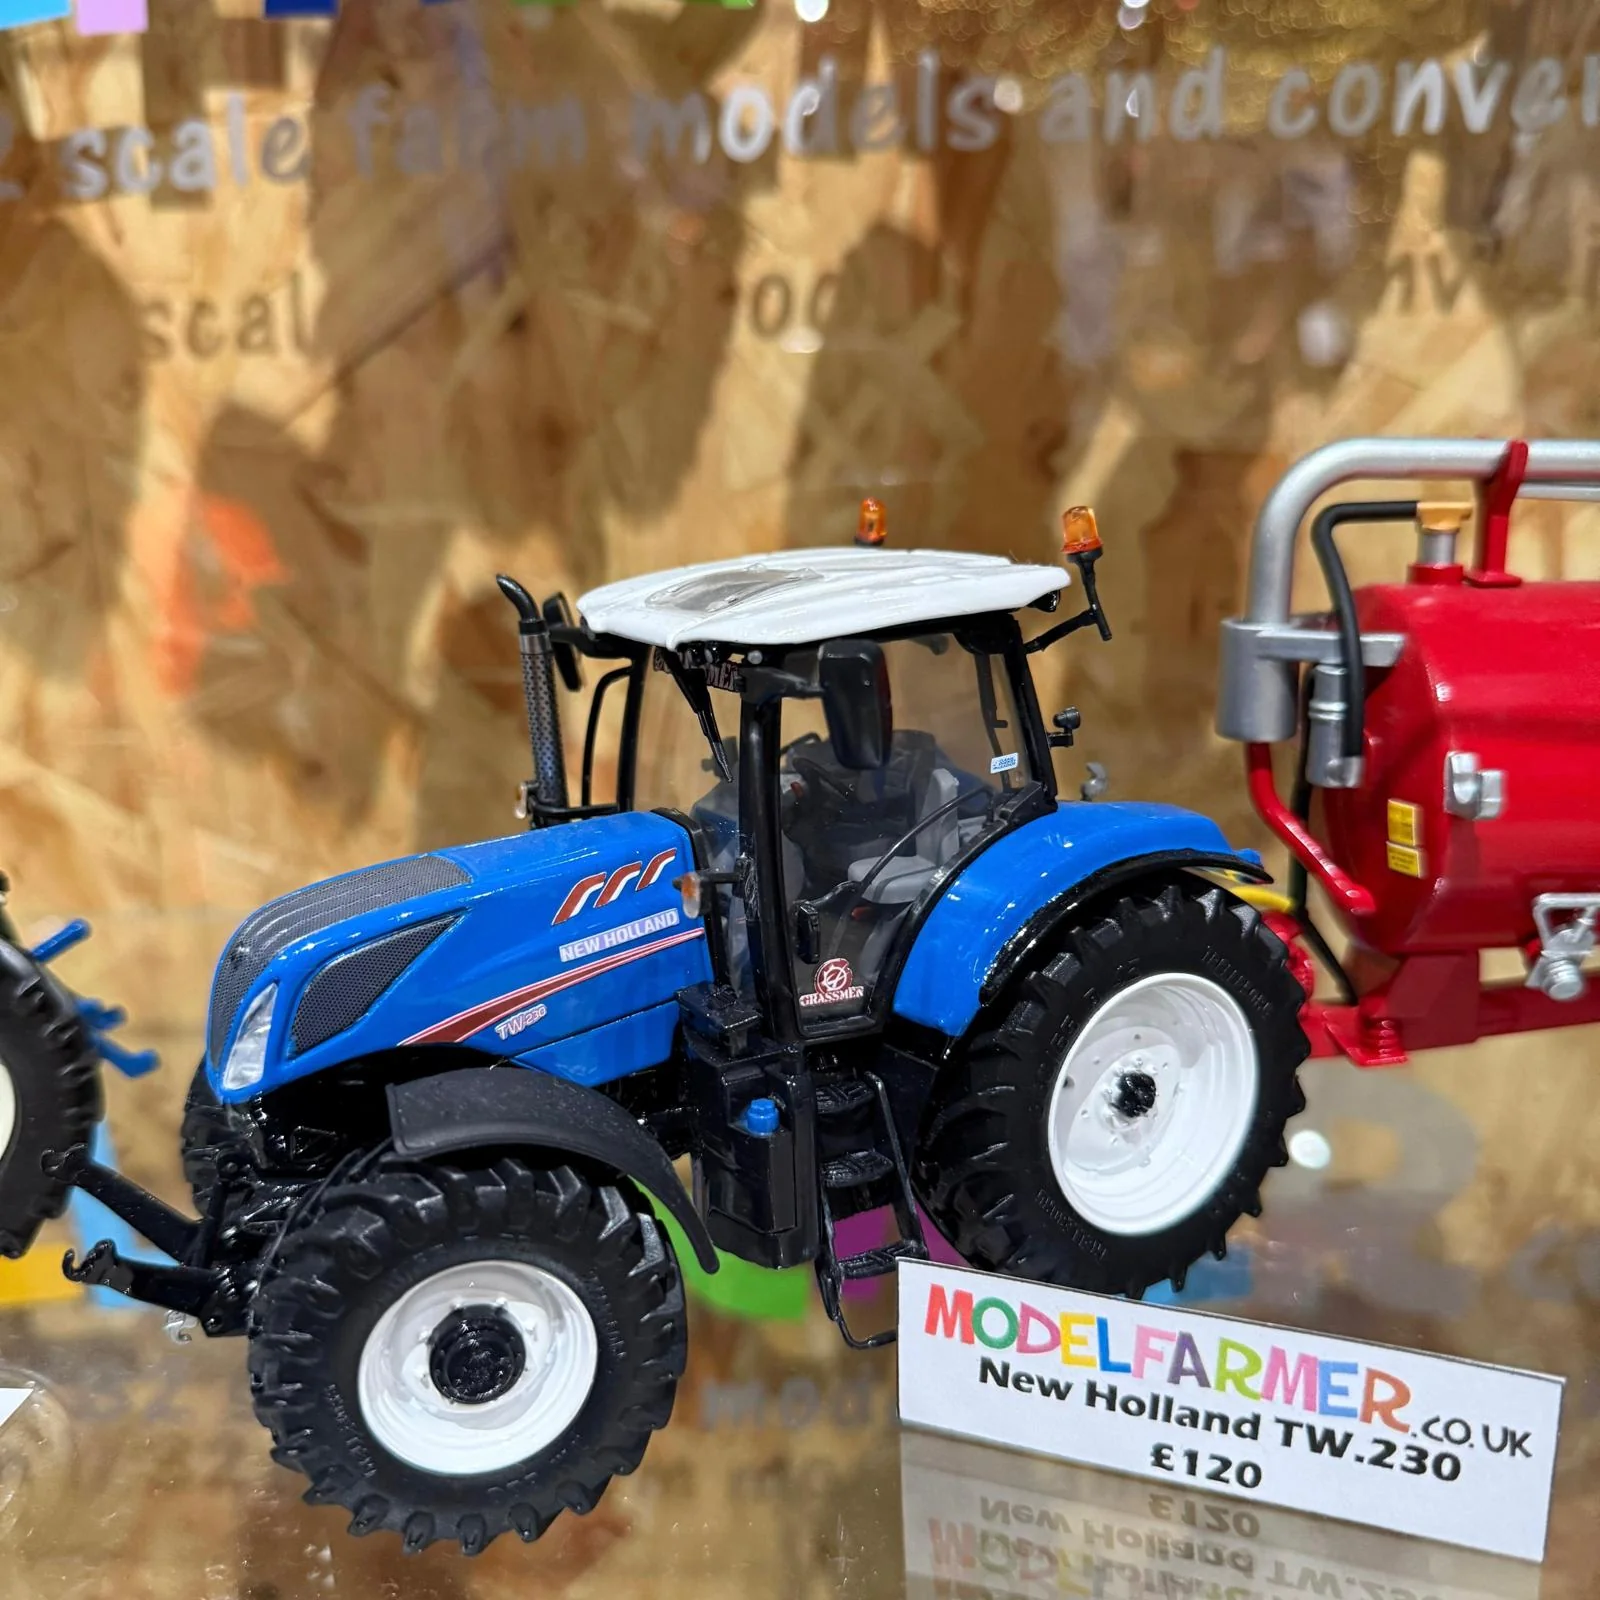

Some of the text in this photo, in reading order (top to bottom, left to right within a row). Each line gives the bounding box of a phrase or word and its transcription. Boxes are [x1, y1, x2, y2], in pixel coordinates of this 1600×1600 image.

[60, 90, 309, 199] scale
[631, 46, 999, 164] models
[1039, 45, 1226, 144] and
[561, 909, 679, 961] NEW HOLLAND
[799, 985, 864, 1007] GRASSMEN
[979, 1357, 1461, 1482] New Holland TW.230
[1151, 1444, 1262, 1489] £120
